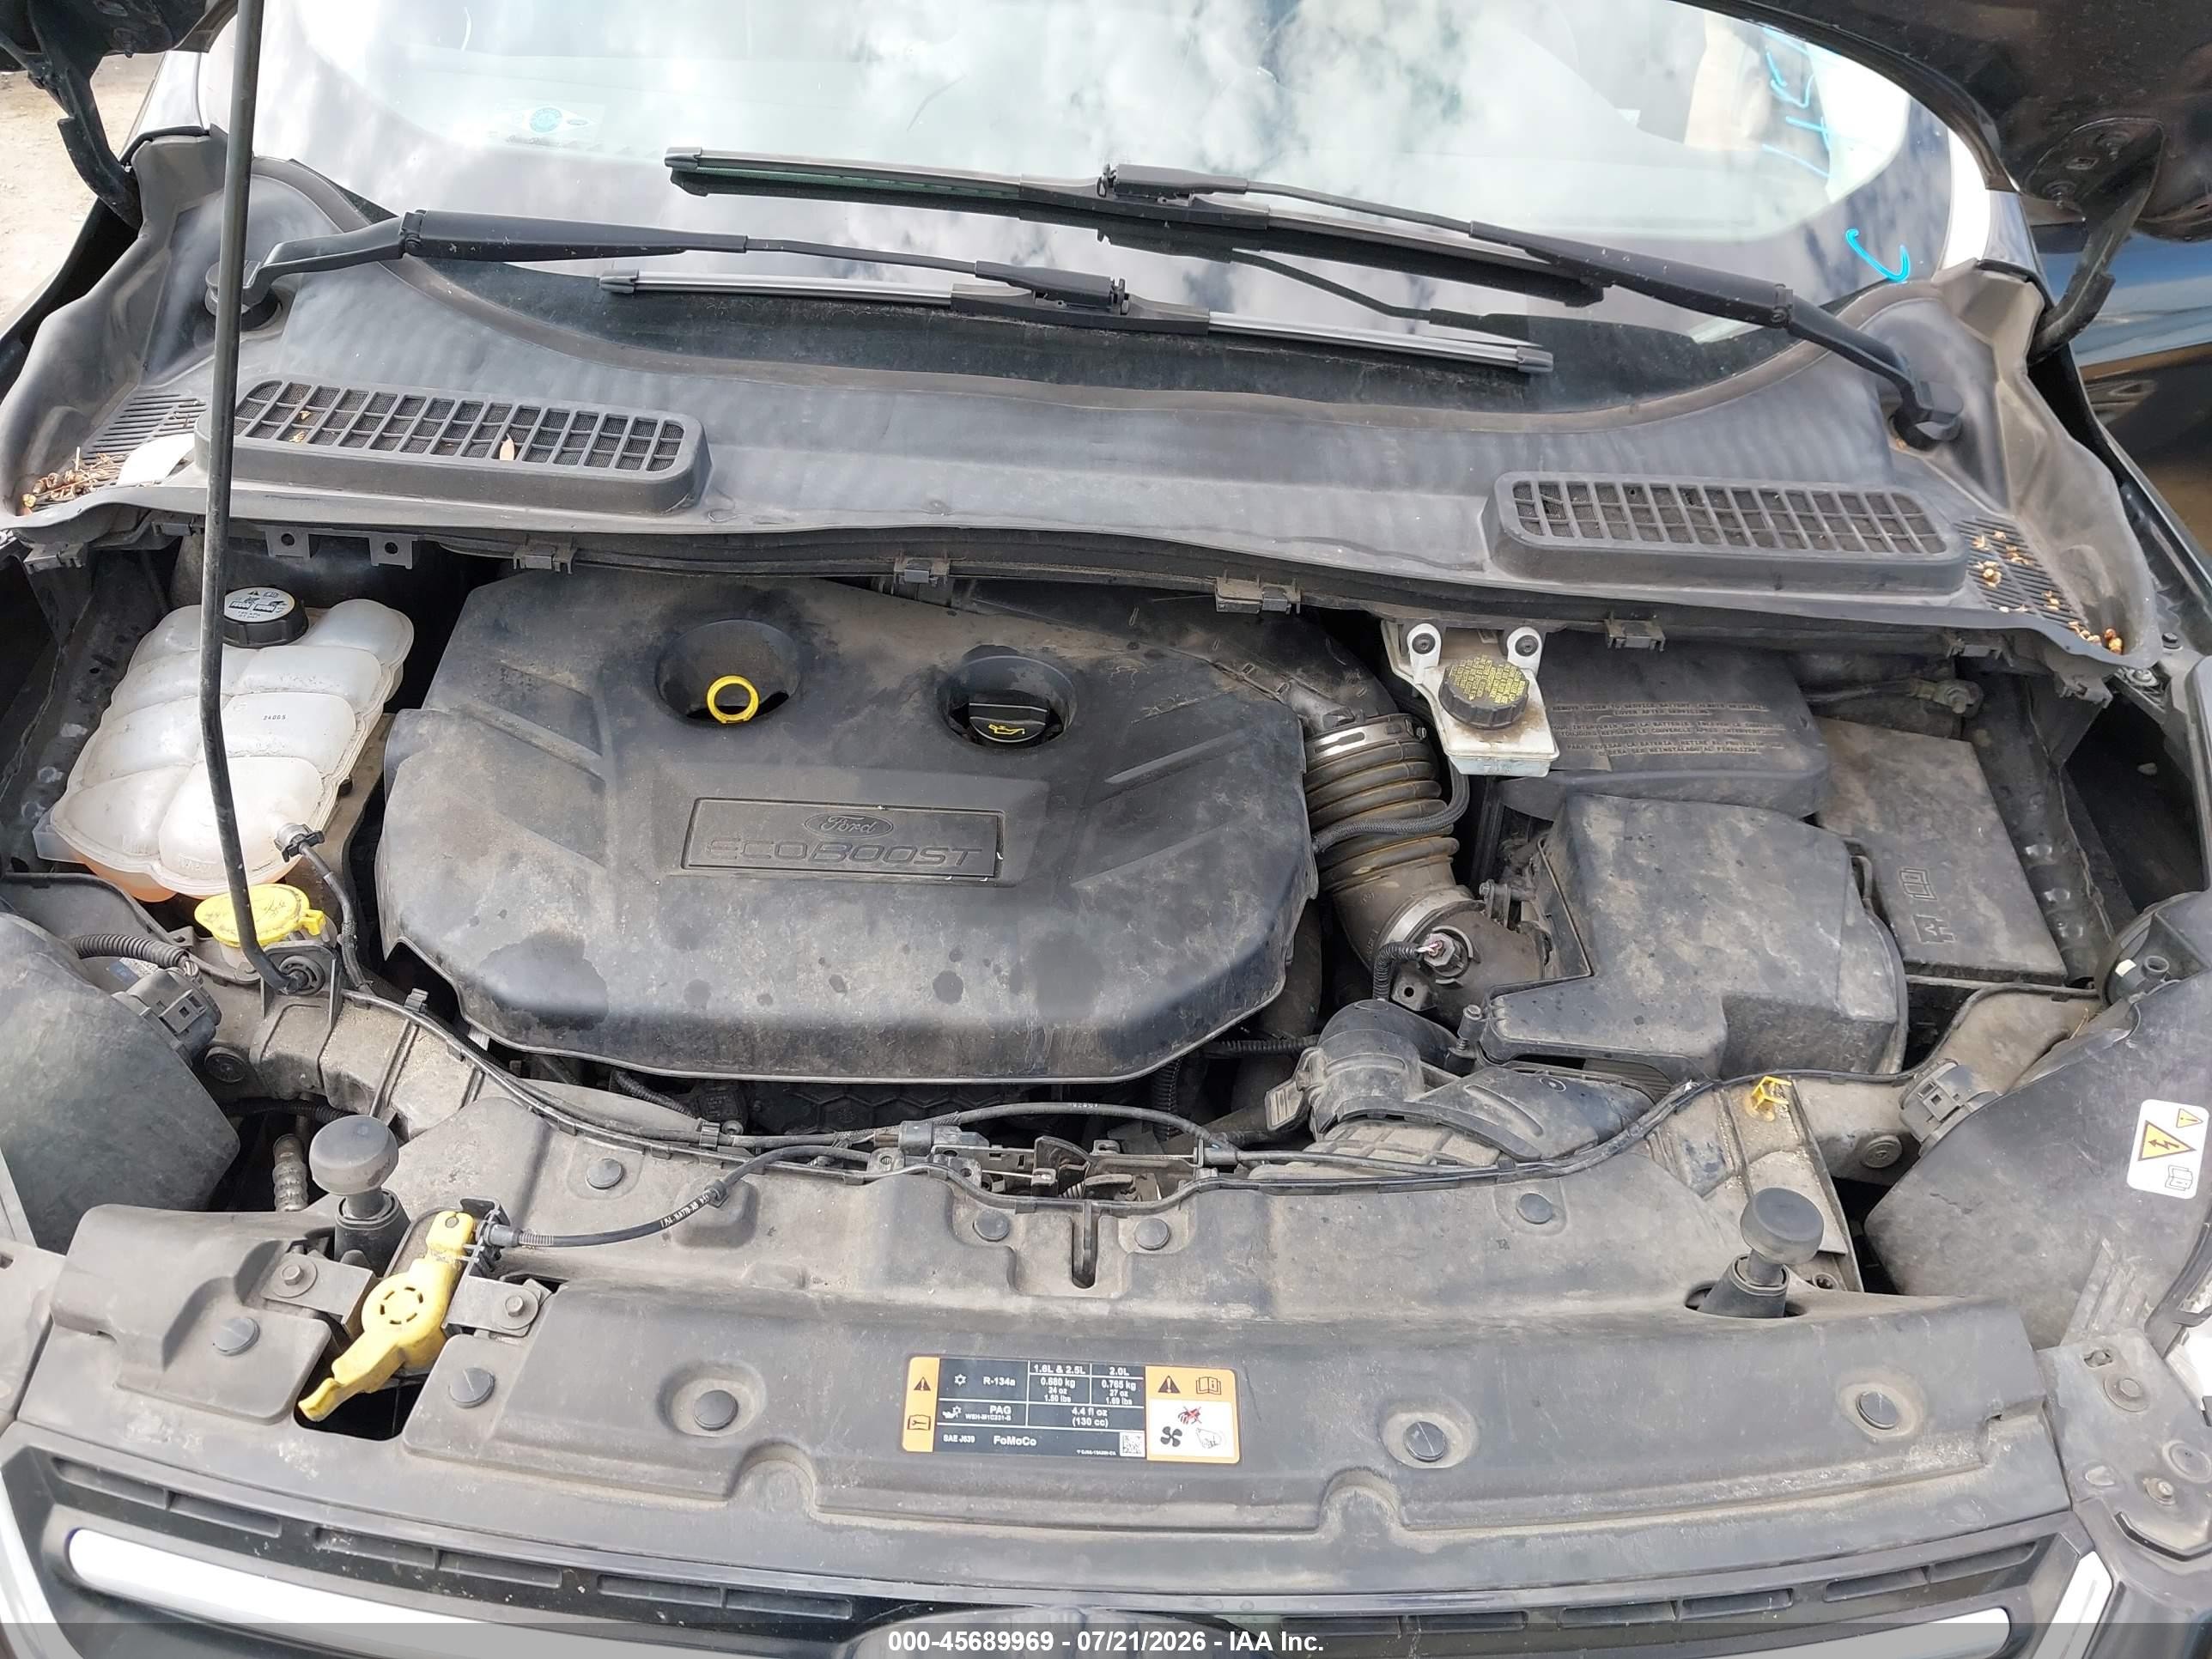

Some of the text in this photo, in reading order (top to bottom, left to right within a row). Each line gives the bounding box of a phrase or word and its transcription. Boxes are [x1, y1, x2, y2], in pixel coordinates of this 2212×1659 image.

[819, 814, 877, 835] Ford
[706, 837, 982, 867] ECOBOOST
[1033, 1364, 1086, 1375] 1.6L & 2.5L
[1109, 1367, 1130, 1376] 2.0L
[982, 1376, 1016, 1387] R-134a
[1040, 1376, 1076, 1389] 0.680 kg
[1101, 1379, 1137, 1391] 0.765 kg
[989, 1405, 1012, 1414] PAG
[1071, 1407, 1085, 1415] 4.4
[1088, 1407, 1094, 1416] fl
[1072, 1417, 1109, 1428] (130 cc)
[943, 1434, 958, 1443] SAE
[993, 1435, 1037, 1447] FoMoCo
